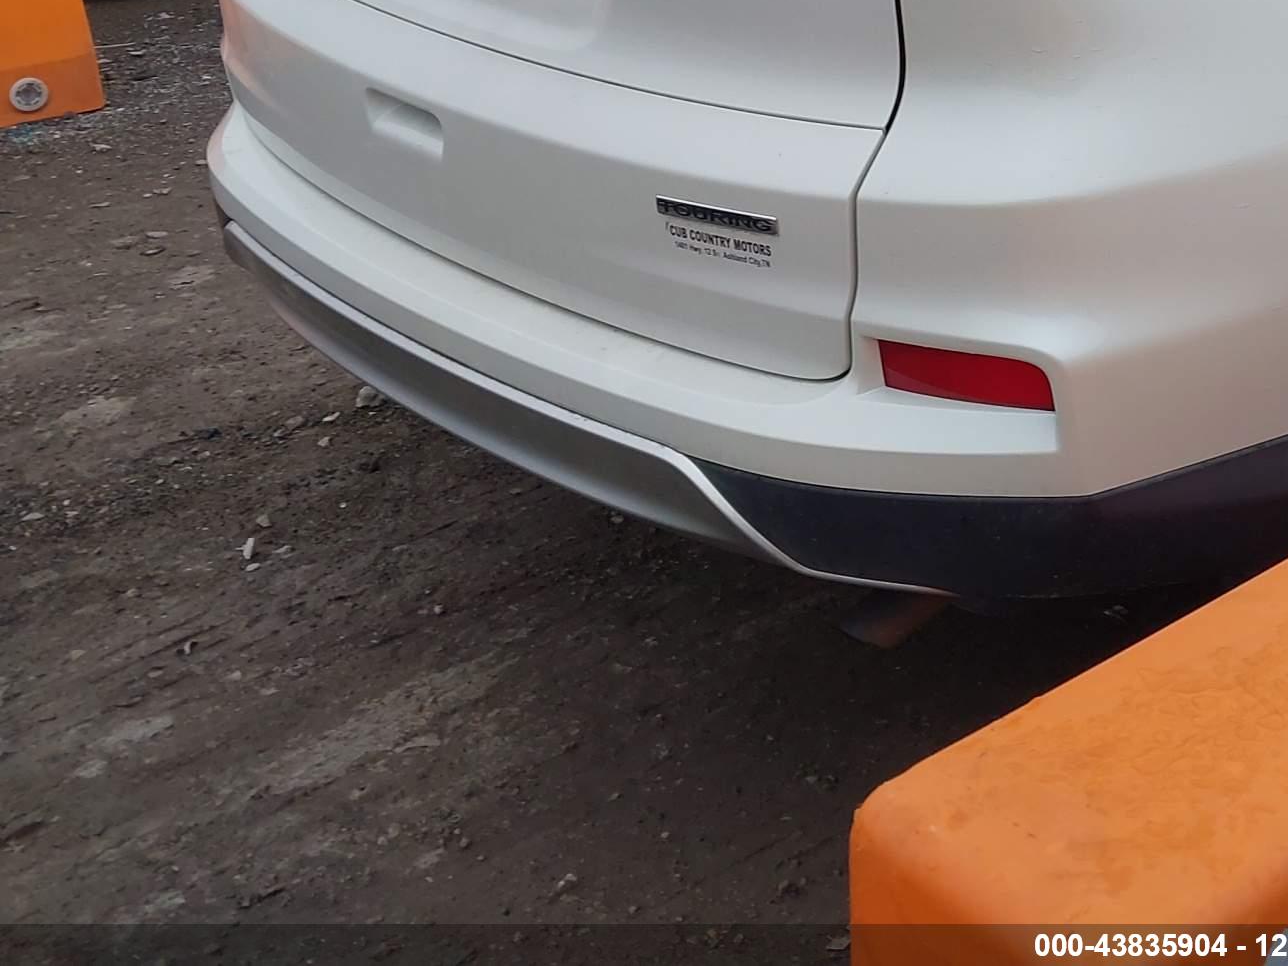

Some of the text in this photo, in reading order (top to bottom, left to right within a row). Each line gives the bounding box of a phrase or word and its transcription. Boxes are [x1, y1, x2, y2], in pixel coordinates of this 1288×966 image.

[658, 199, 774, 233] TOURING
[669, 224, 772, 256] CUB COUNTRY MOTORS
